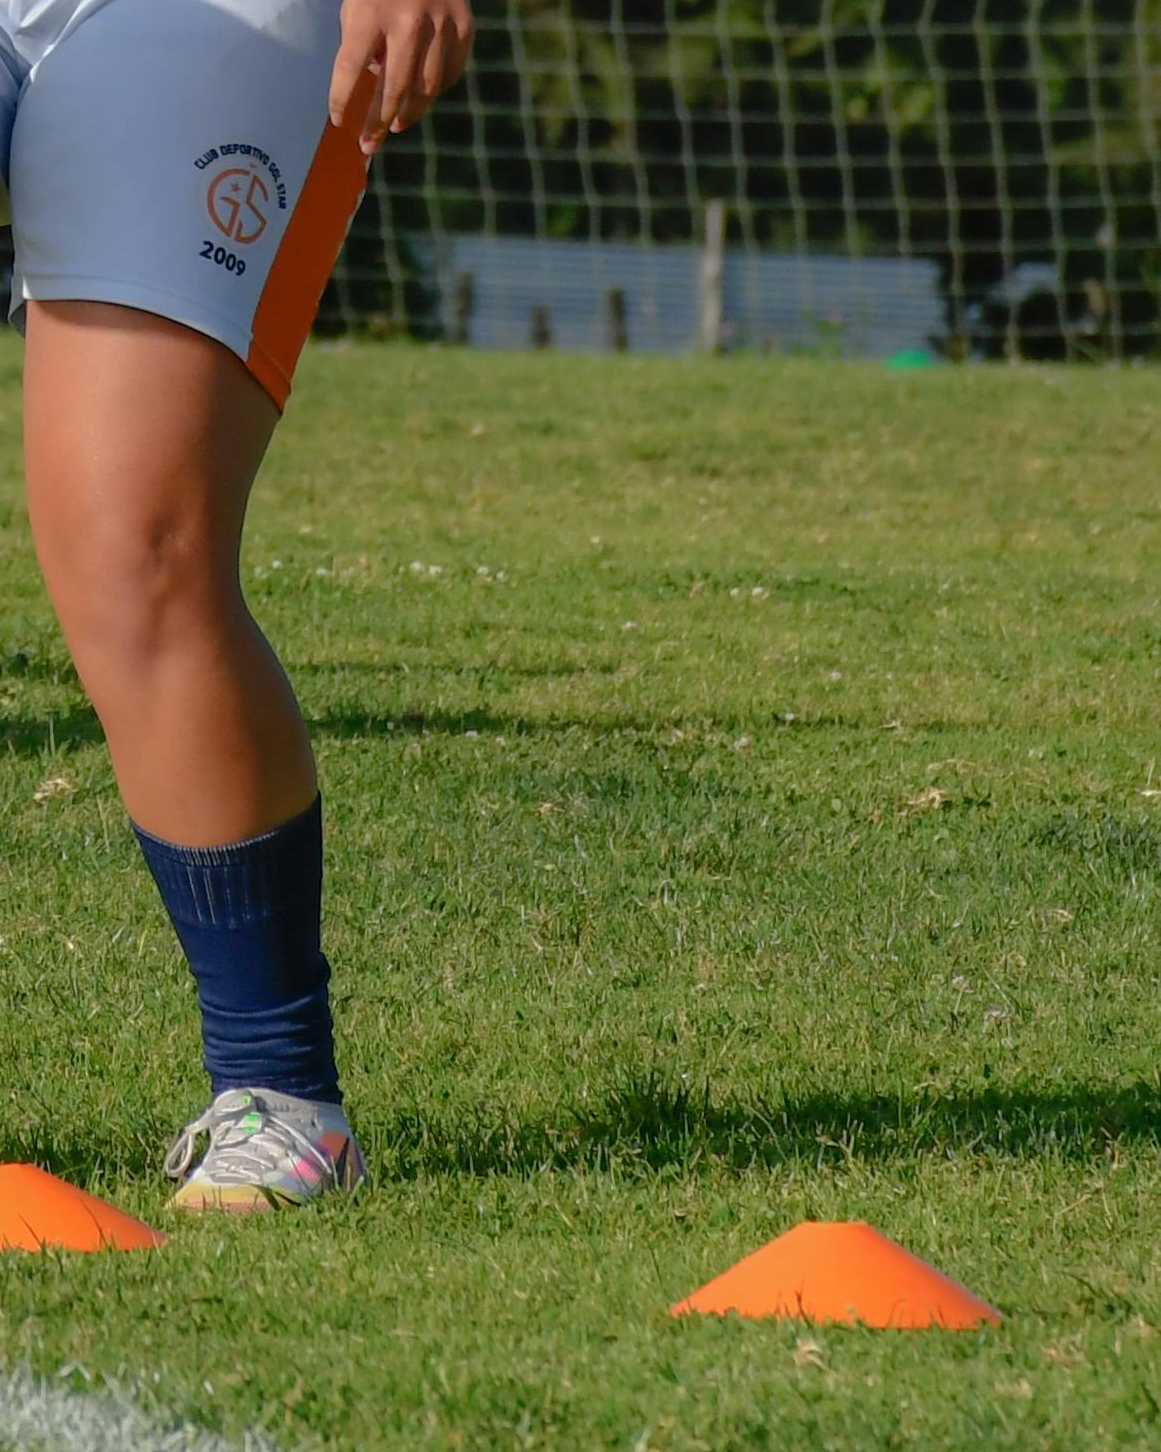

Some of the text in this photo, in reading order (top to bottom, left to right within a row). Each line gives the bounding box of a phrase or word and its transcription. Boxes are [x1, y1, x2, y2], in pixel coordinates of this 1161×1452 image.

[194, 148, 219, 170] CLUB
[219, 143, 270, 166] DEPORTIVO
[198, 240, 246, 276] 2009
